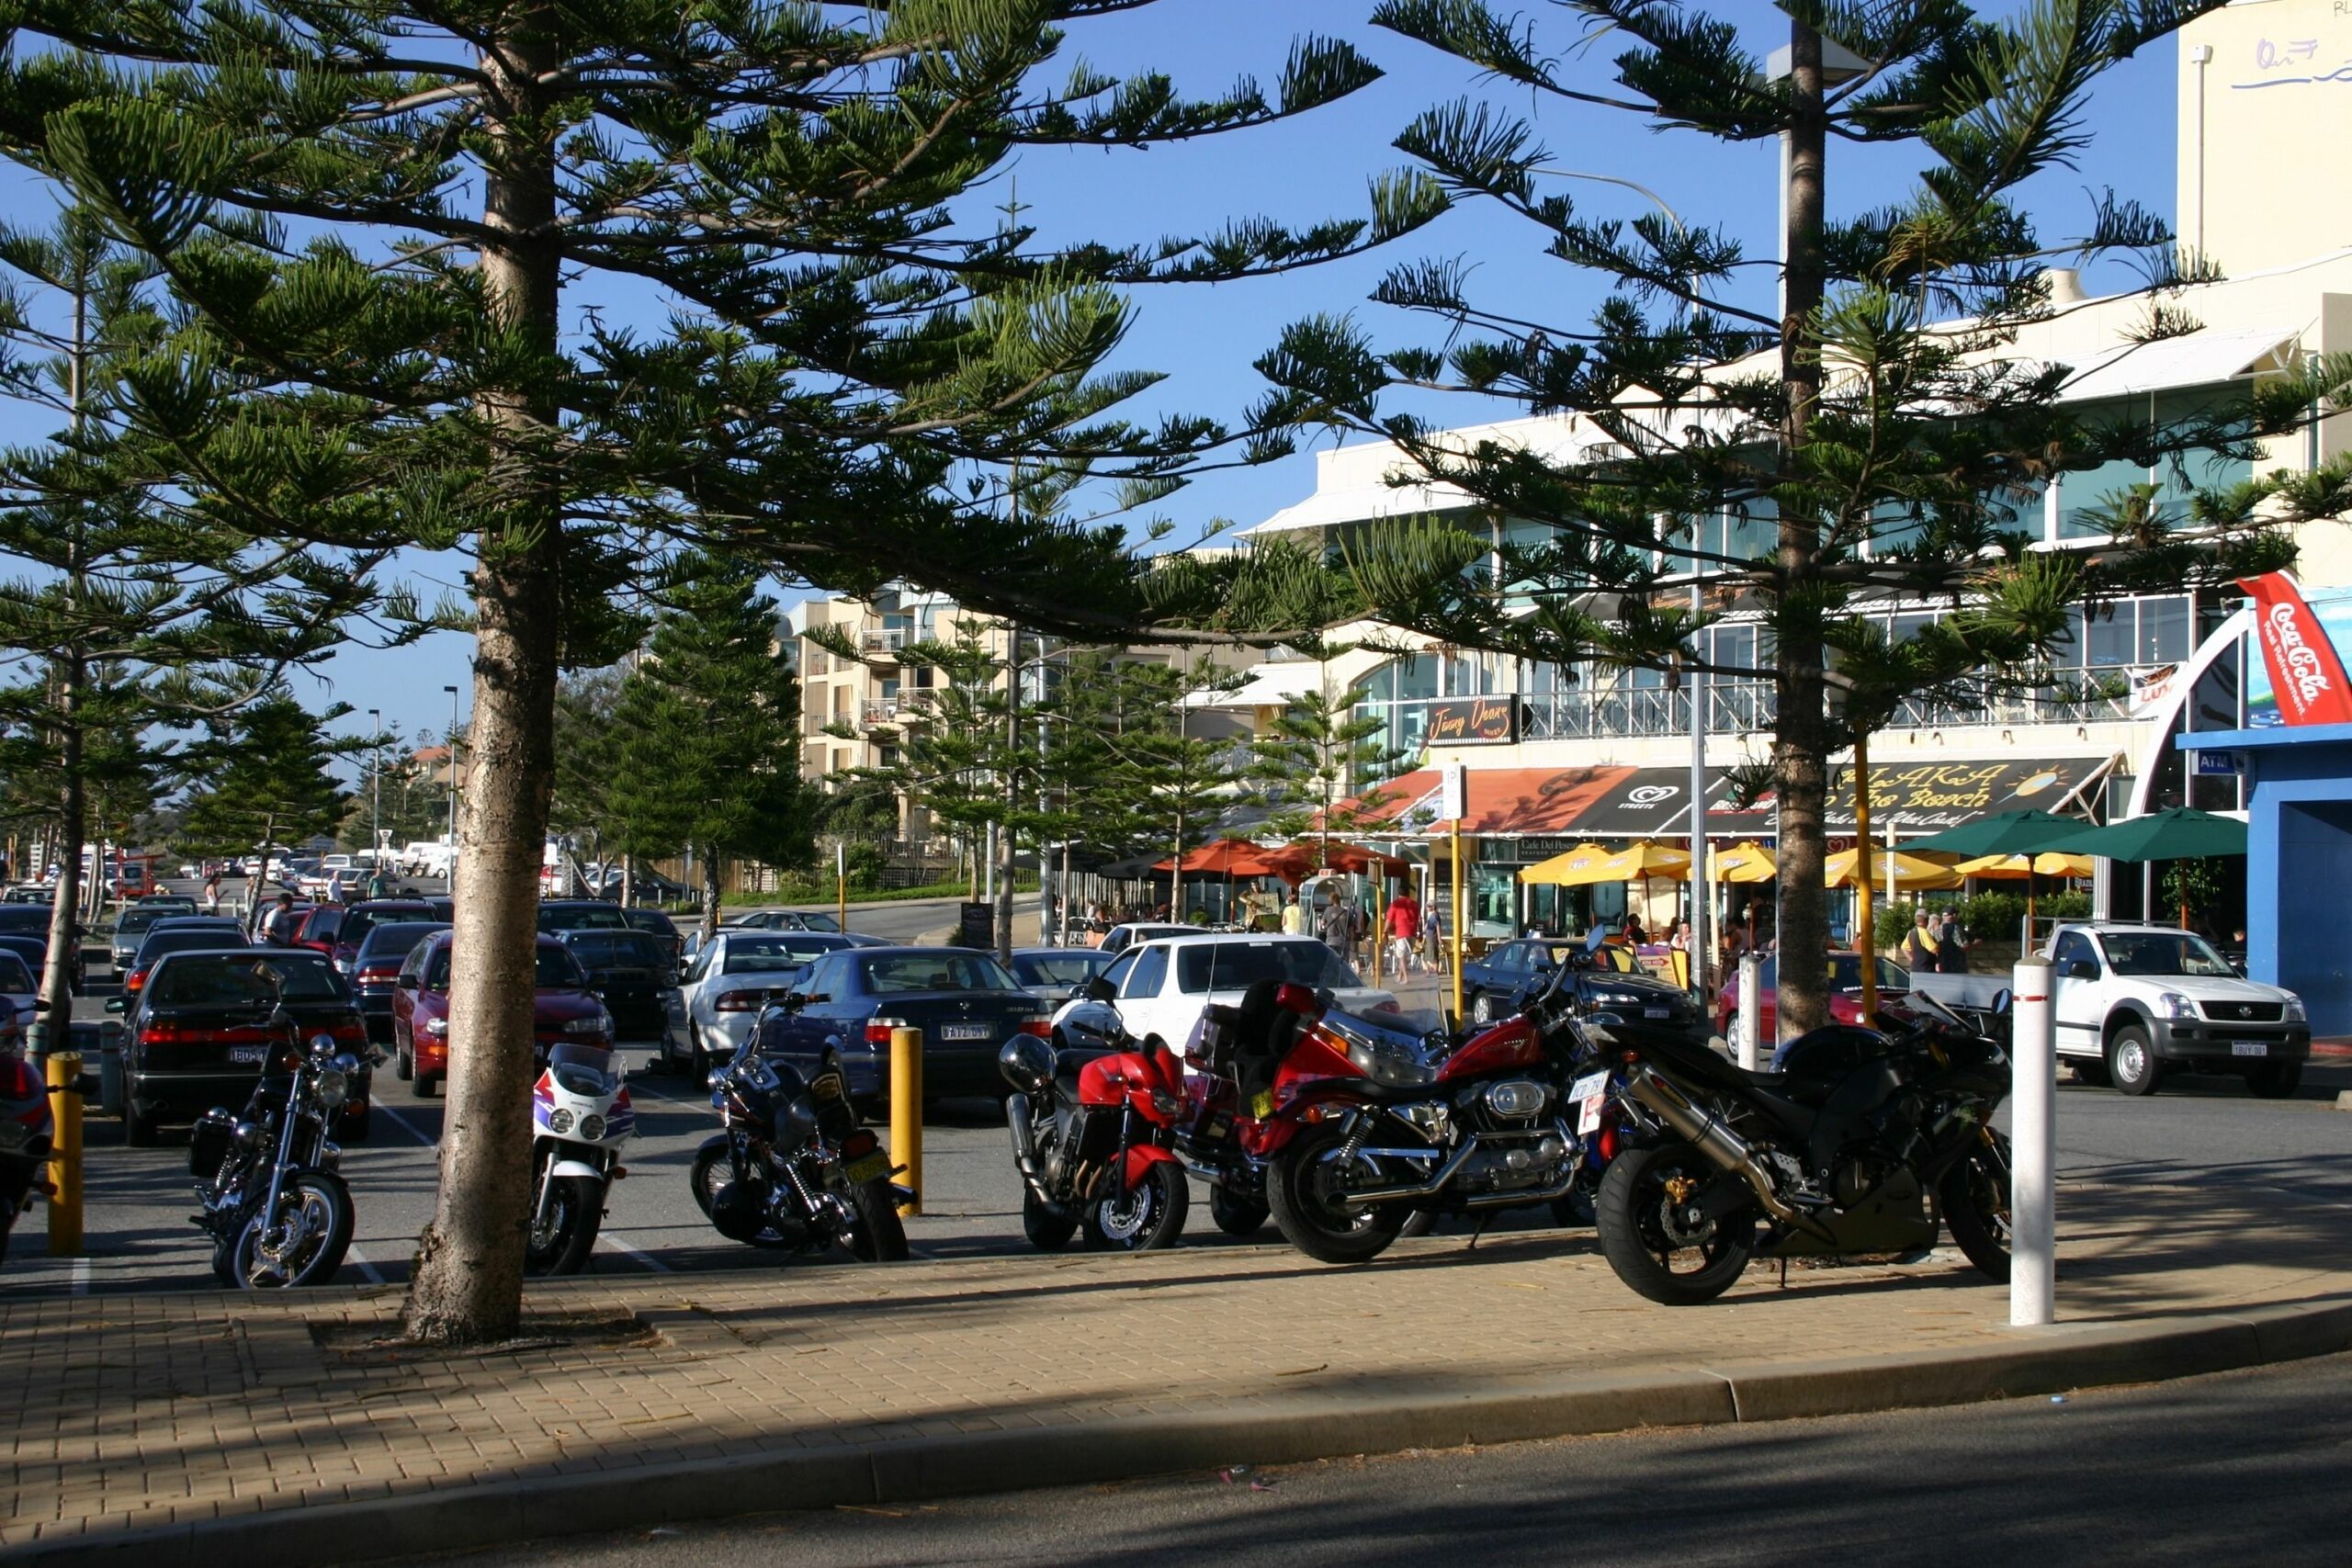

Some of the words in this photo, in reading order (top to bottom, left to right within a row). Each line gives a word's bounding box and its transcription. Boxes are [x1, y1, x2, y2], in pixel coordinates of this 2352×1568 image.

[2263, 620, 2278, 646] Real
[2270, 602, 2331, 703] Coca-Cola
[2200, 756, 2228, 768] ATM
[1901, 787, 1991, 808] Beach
[1521, 839, 1539, 850] Cafe
[1541, 839, 1555, 850] Del
